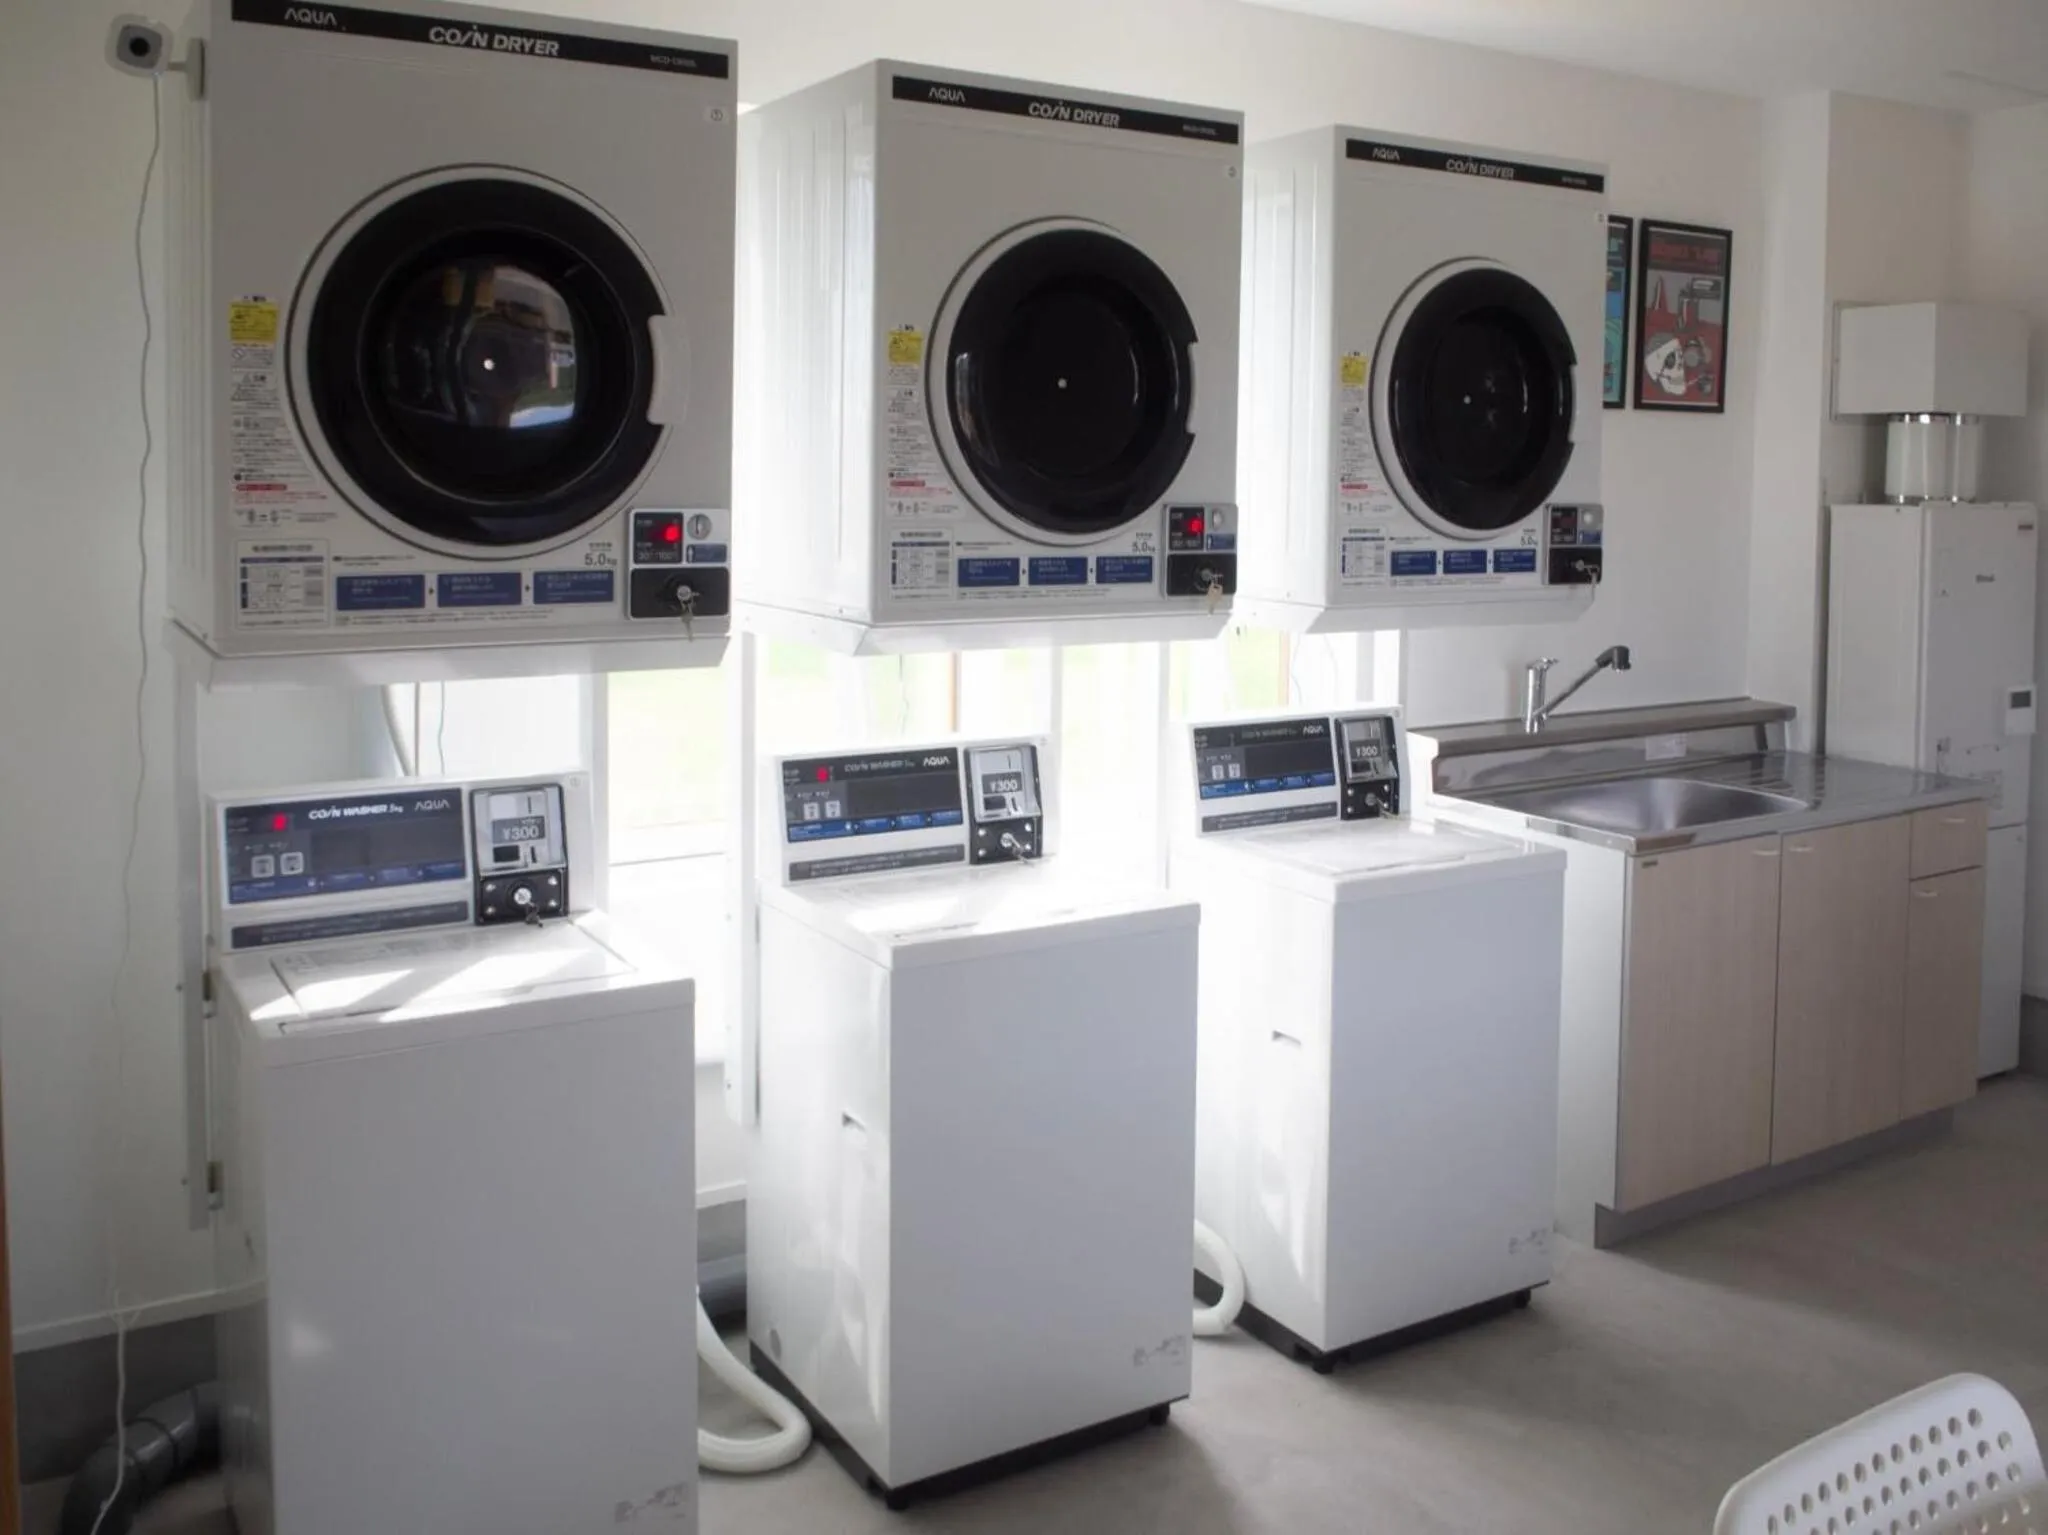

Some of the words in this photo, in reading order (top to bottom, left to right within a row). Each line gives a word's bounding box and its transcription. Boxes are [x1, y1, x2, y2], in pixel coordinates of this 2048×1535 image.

[285, 8, 337, 27] AQUA
[429, 24, 489, 49] COIN
[493, 34, 560, 57] DRYER
[929, 86, 966, 103] AQUA
[1028, 101, 1071, 121] COIN
[1073, 108, 1121, 127] DRYER
[1372, 147, 1400, 161] AQUA
[1479, 164, 1515, 180] DRYER
[923, 755, 951, 767] AQUA
[989, 779, 1018, 793] ¥300
[308, 804, 341, 820] COIN
[343, 804, 388, 817] WASHER
[414, 799, 450, 812] AQUA
[502, 825, 540, 841] ¥300
